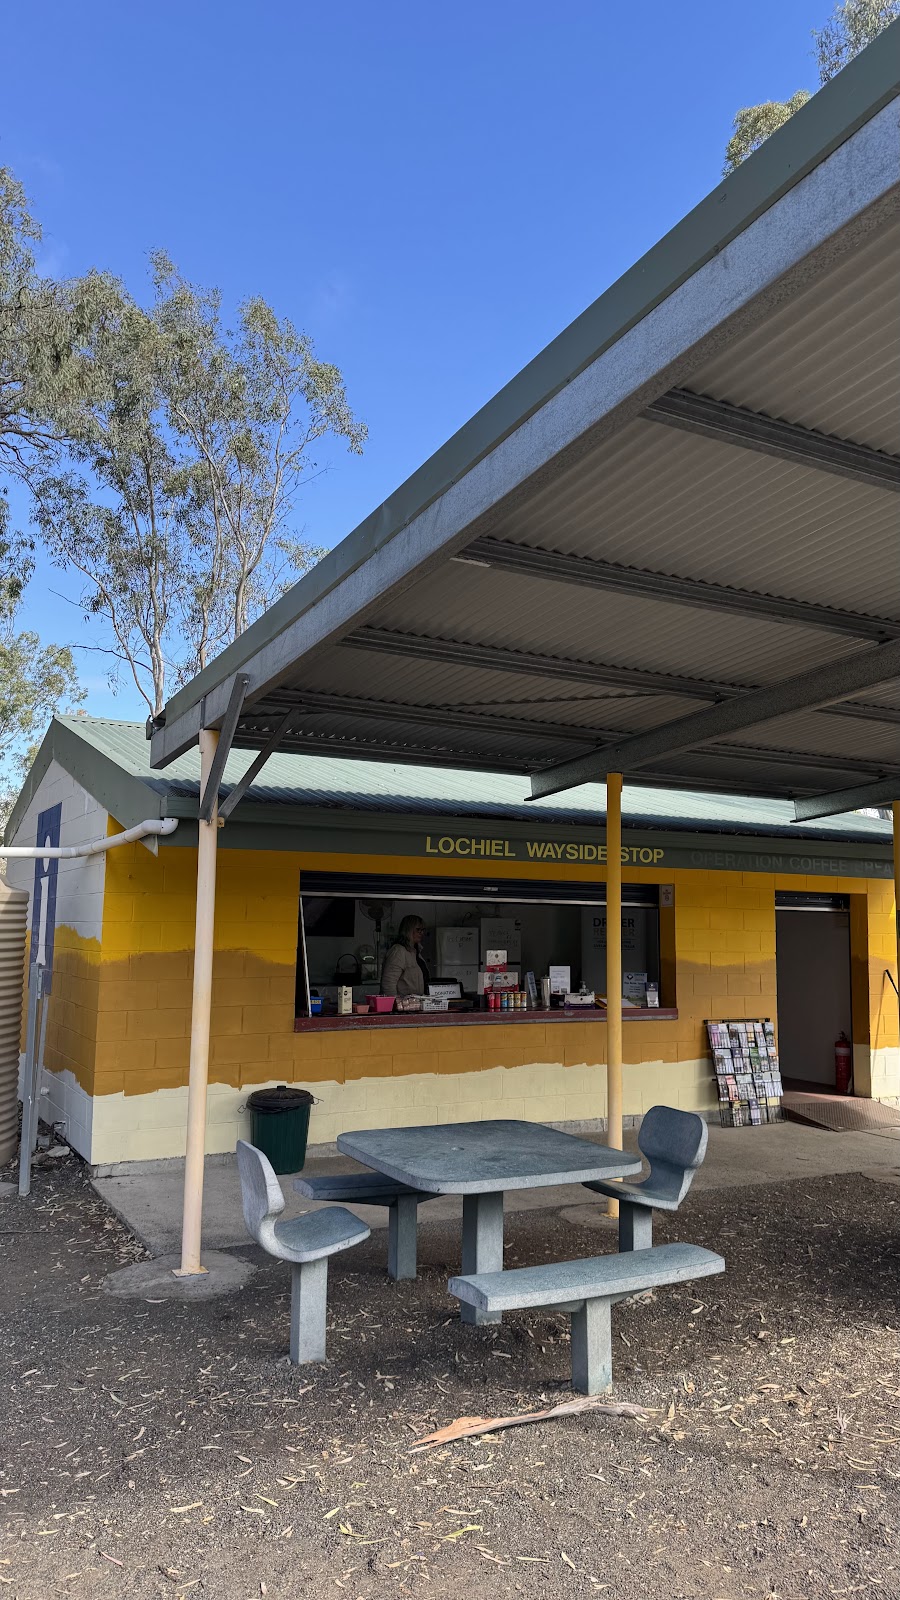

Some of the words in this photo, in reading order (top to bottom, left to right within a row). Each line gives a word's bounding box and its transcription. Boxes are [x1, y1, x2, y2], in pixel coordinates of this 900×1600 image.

[426, 836, 516, 857] LOCHIEL
[526, 841, 608, 861] WAYSIDE
[620, 846, 664, 863] STOP
[690, 850, 783, 869] OPERATION
[789, 856, 847, 873] COFFEE
